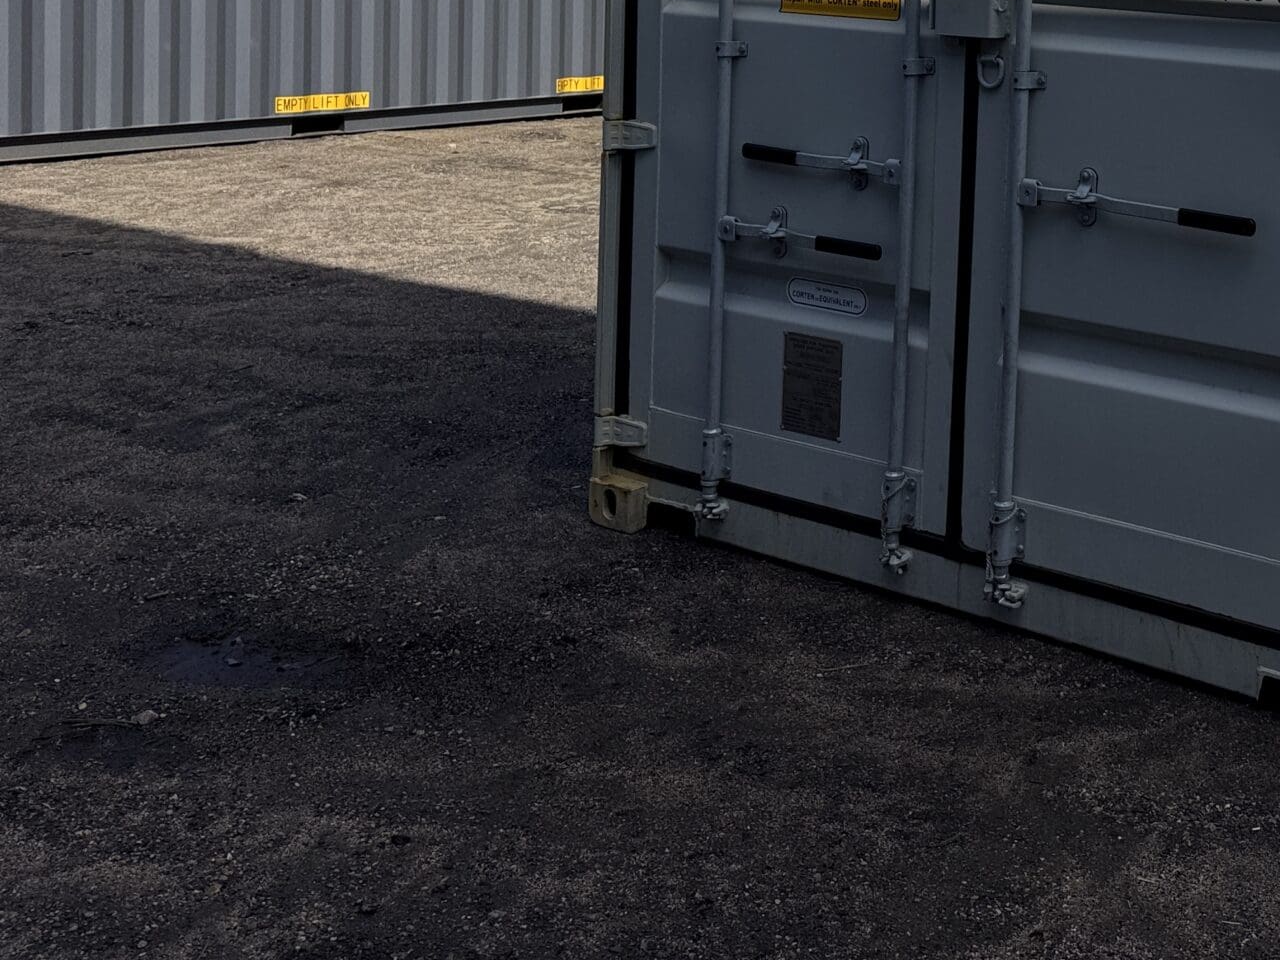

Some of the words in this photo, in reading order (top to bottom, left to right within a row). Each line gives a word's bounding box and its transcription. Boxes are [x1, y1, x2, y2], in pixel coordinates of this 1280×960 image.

[882, 0, 898, 11] only
[276, 97, 309, 112] EMPTY
[312, 95, 340, 109] LIFT
[345, 93, 368, 107] ONLY
